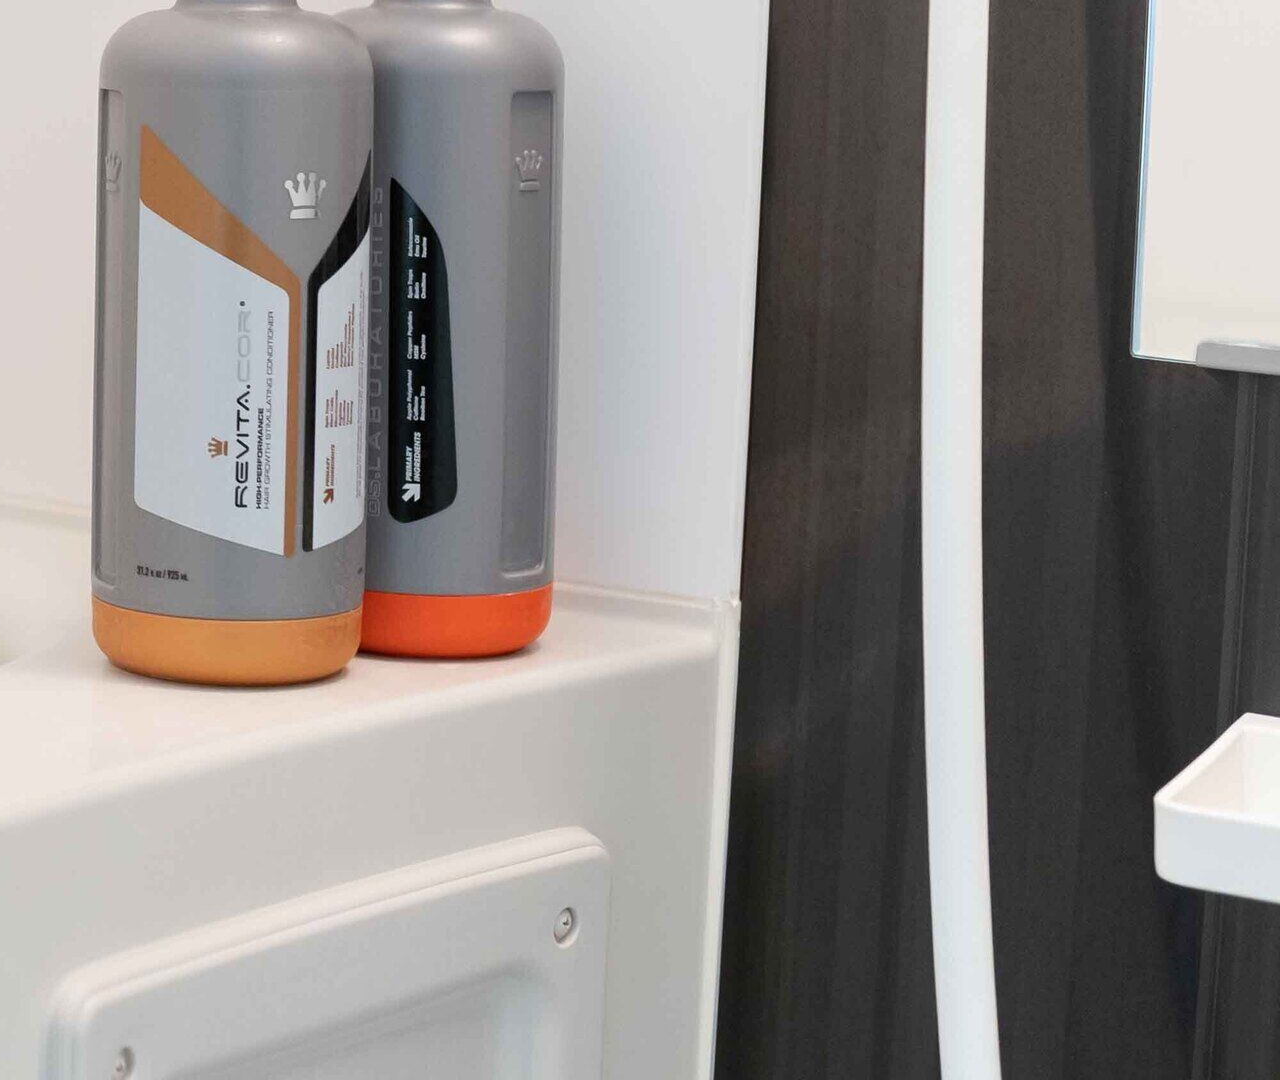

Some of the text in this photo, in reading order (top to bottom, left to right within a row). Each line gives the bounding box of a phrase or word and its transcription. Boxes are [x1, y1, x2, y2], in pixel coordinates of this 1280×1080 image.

[263, 311, 274, 510] HAIR GROWTH STIMULATING CONDITIONER
[405, 446, 413, 482] PRIMARY
[413, 431, 421, 482] INGREDIENTS
